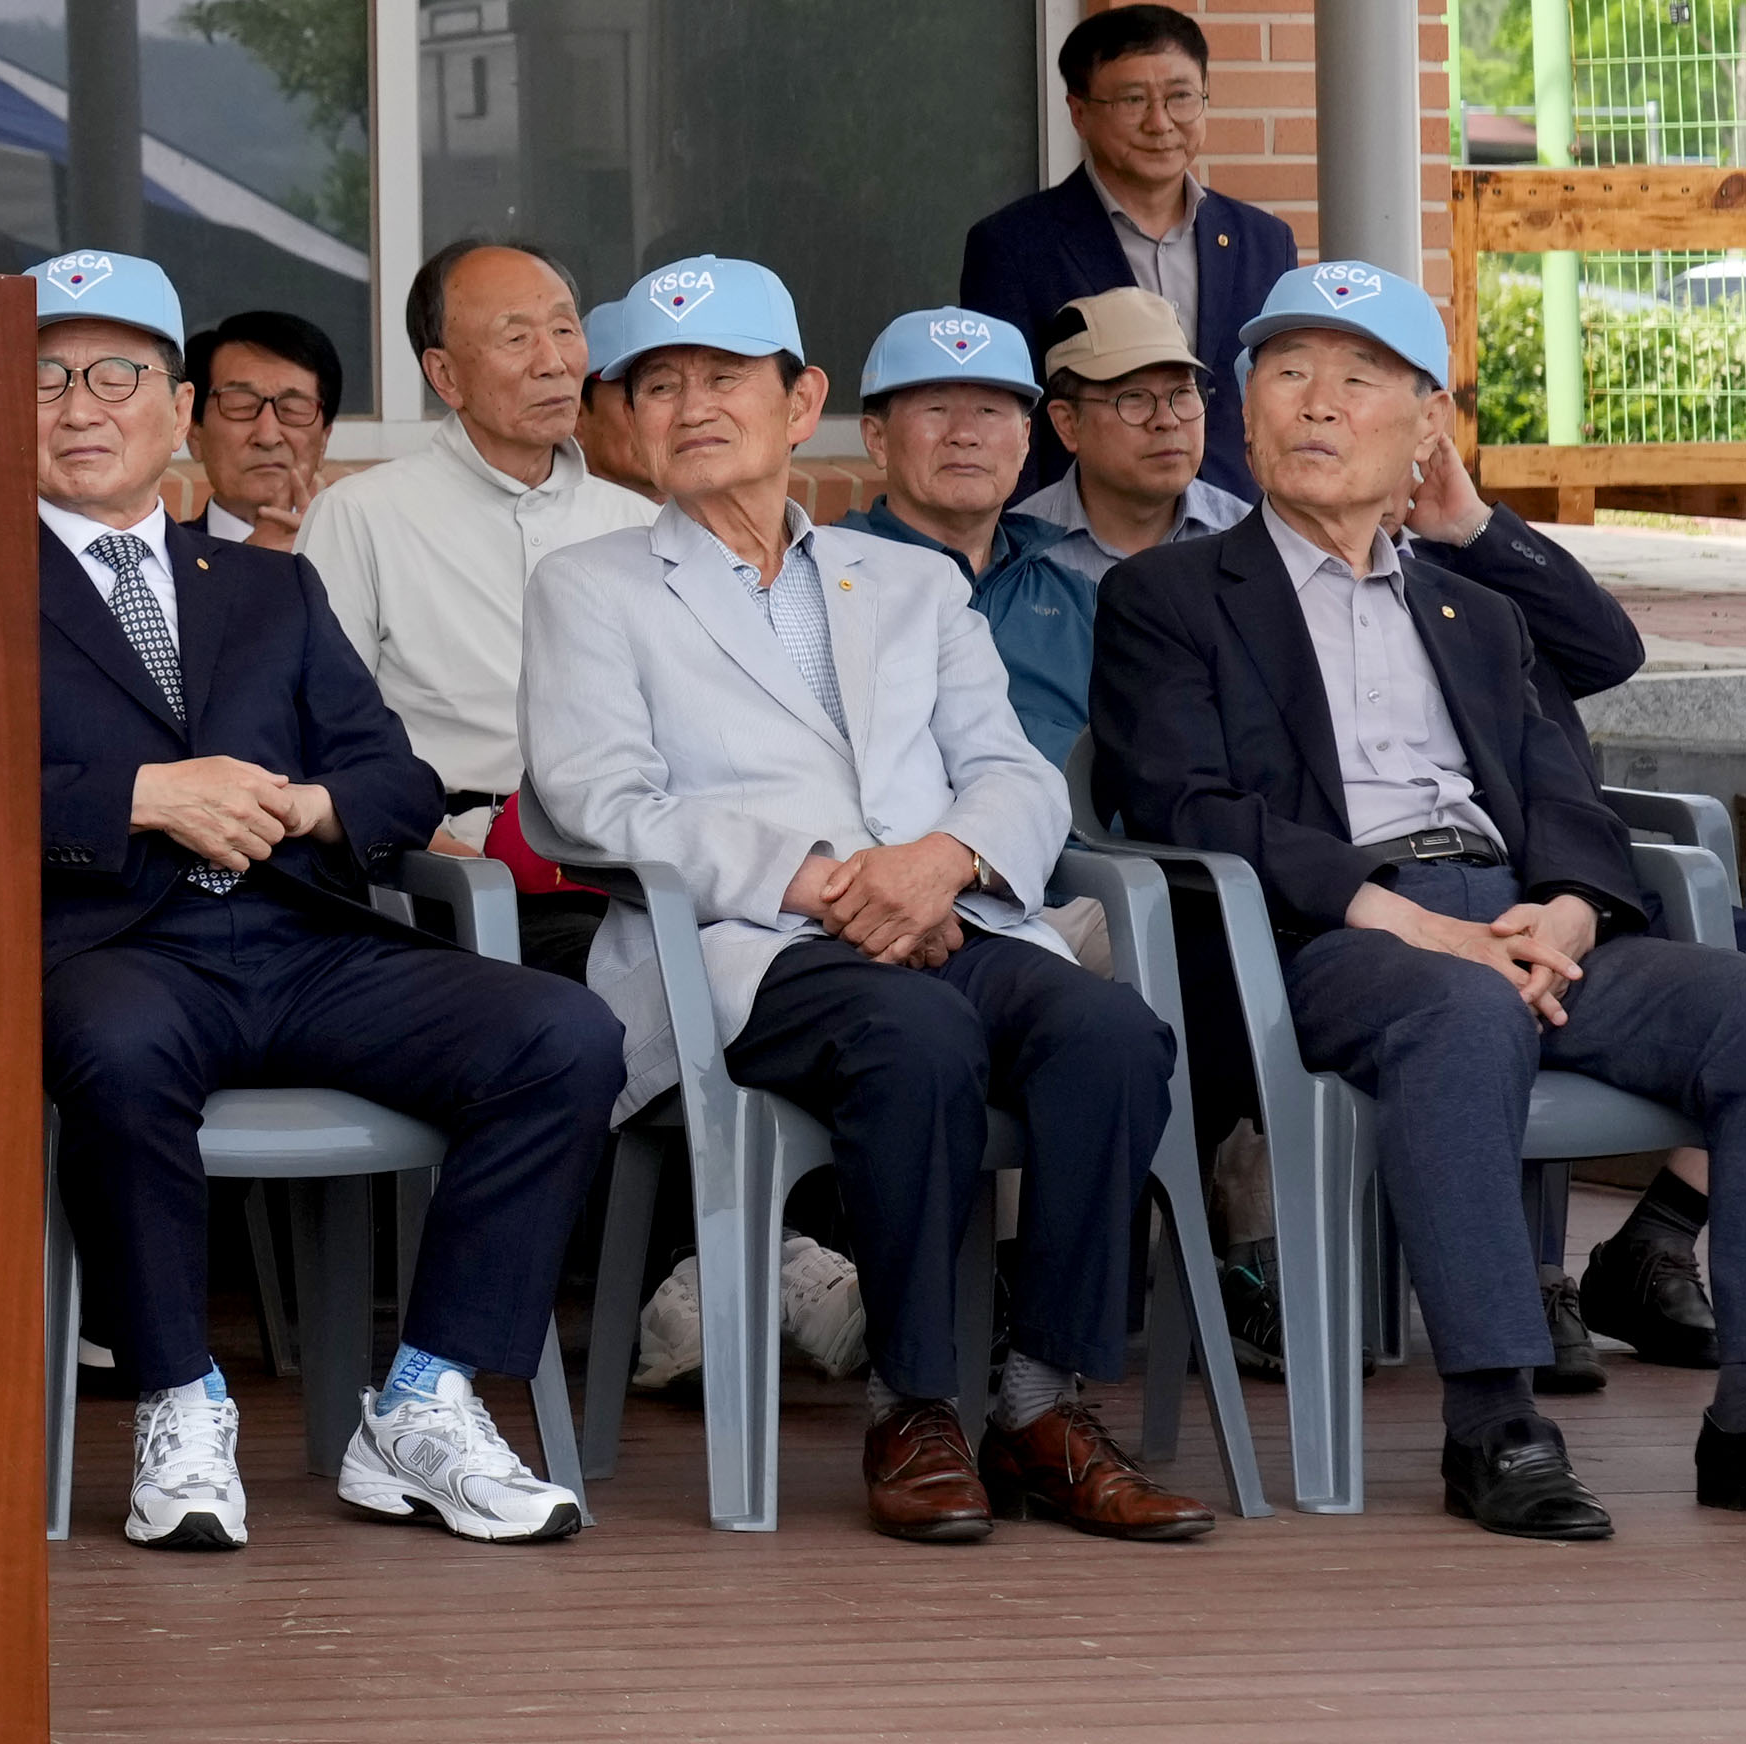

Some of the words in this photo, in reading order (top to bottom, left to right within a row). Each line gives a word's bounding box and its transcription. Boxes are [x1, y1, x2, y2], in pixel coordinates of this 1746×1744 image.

[47, 254, 113, 274] KSCA
[650, 271, 715, 296] KSCA
[1311, 261, 1383, 290] KSCA
[929, 319, 991, 339] KSCA
